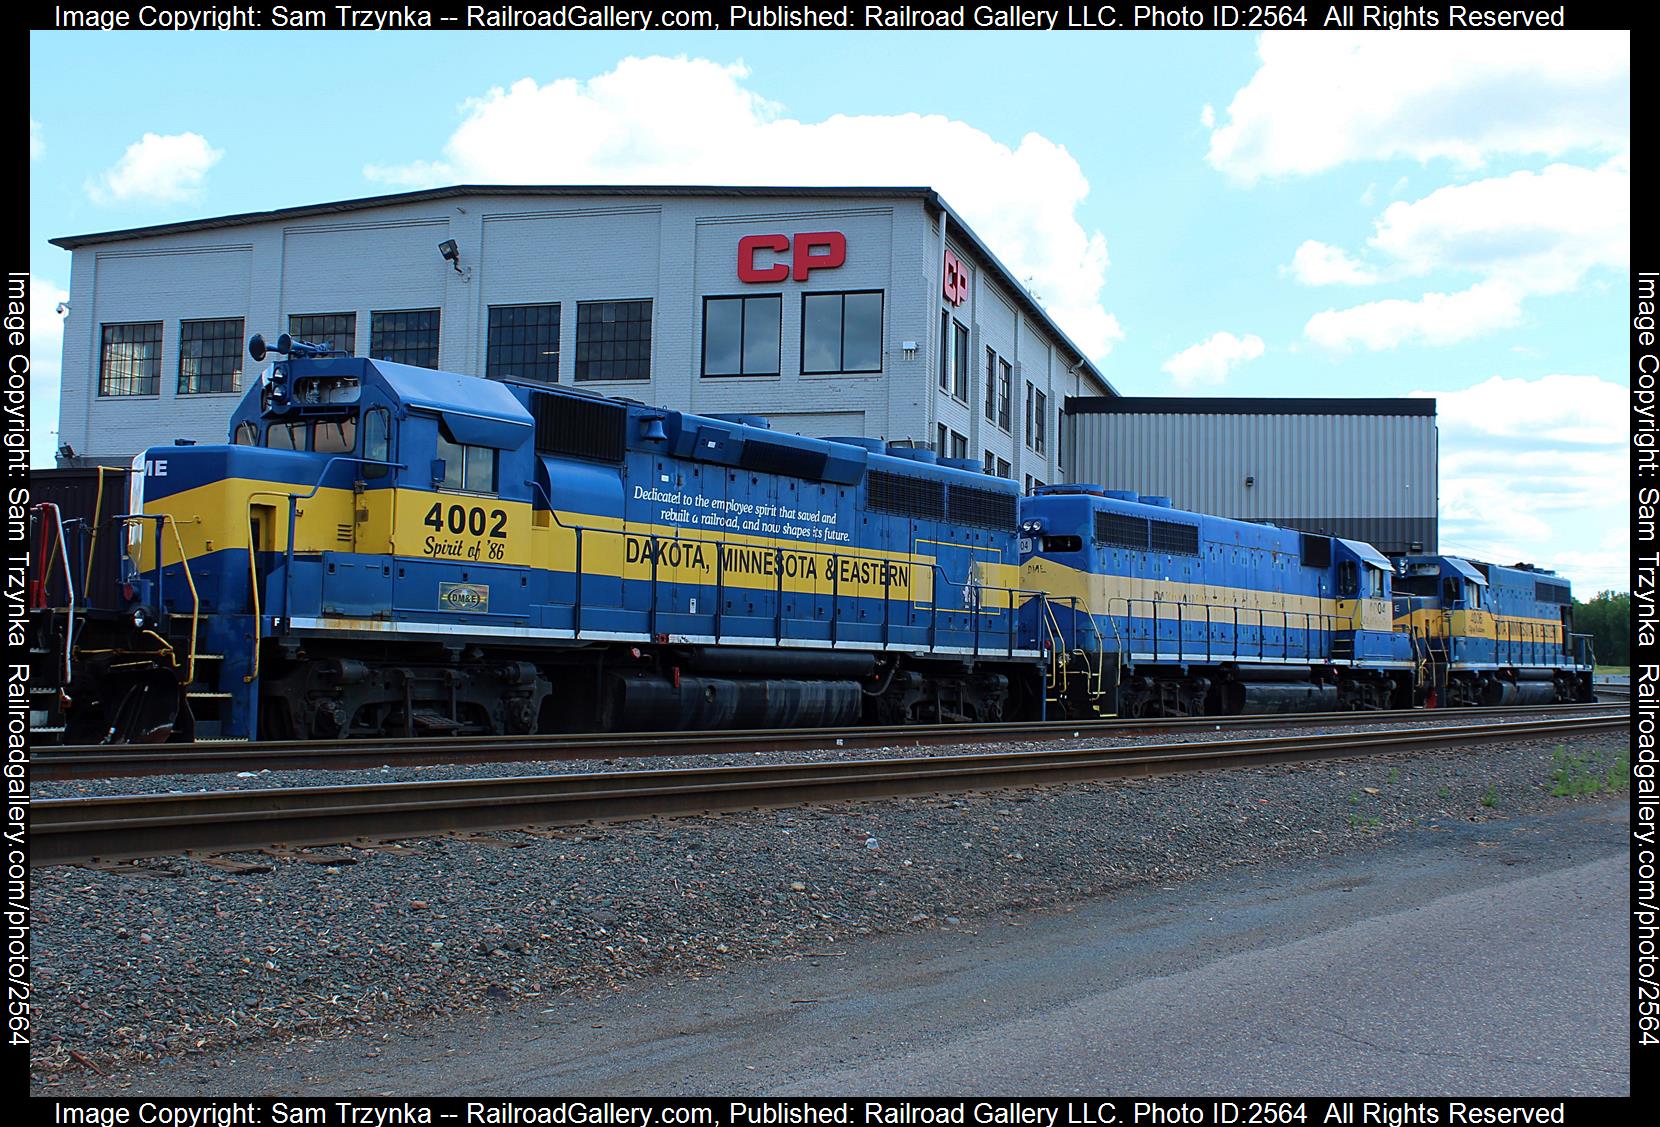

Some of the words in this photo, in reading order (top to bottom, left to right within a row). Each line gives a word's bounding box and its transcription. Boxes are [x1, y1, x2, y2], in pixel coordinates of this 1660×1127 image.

[737, 231, 846, 283] CP
[943, 249, 968, 307] CP
[424, 502, 508, 539] 4002
[634, 486, 680, 504] Dedicated
[683, 494, 693, 506] to
[695, 494, 709, 508] the
[711, 498, 753, 515] employee
[755, 503, 777, 518] spirit
[780, 506, 795, 520] that
[797, 510, 820, 522] saved
[821, 513, 836, 525] and
[660, 508, 690, 523] rebuilt
[692, 514, 698, 524] a
[701, 513, 740, 531] railroad,
[742, 518, 760, 531] and
[762, 522, 780, 533] now
[783, 523, 810, 538] shapes
[812, 525, 823, 538] its
[823, 527, 850, 541] future.
[423, 536, 463, 558] Spirit
[467, 540, 481, 561] of
[486, 540, 505, 560] '86
[626, 537, 710, 574] DAKOTA,
[721, 546, 818, 580] MINNESOTA
[825, 558, 836, 581] &
[841, 560, 908, 588] EASTERN
[452, 593, 477, 603] DM&E
[274, 617, 280, 627] F
